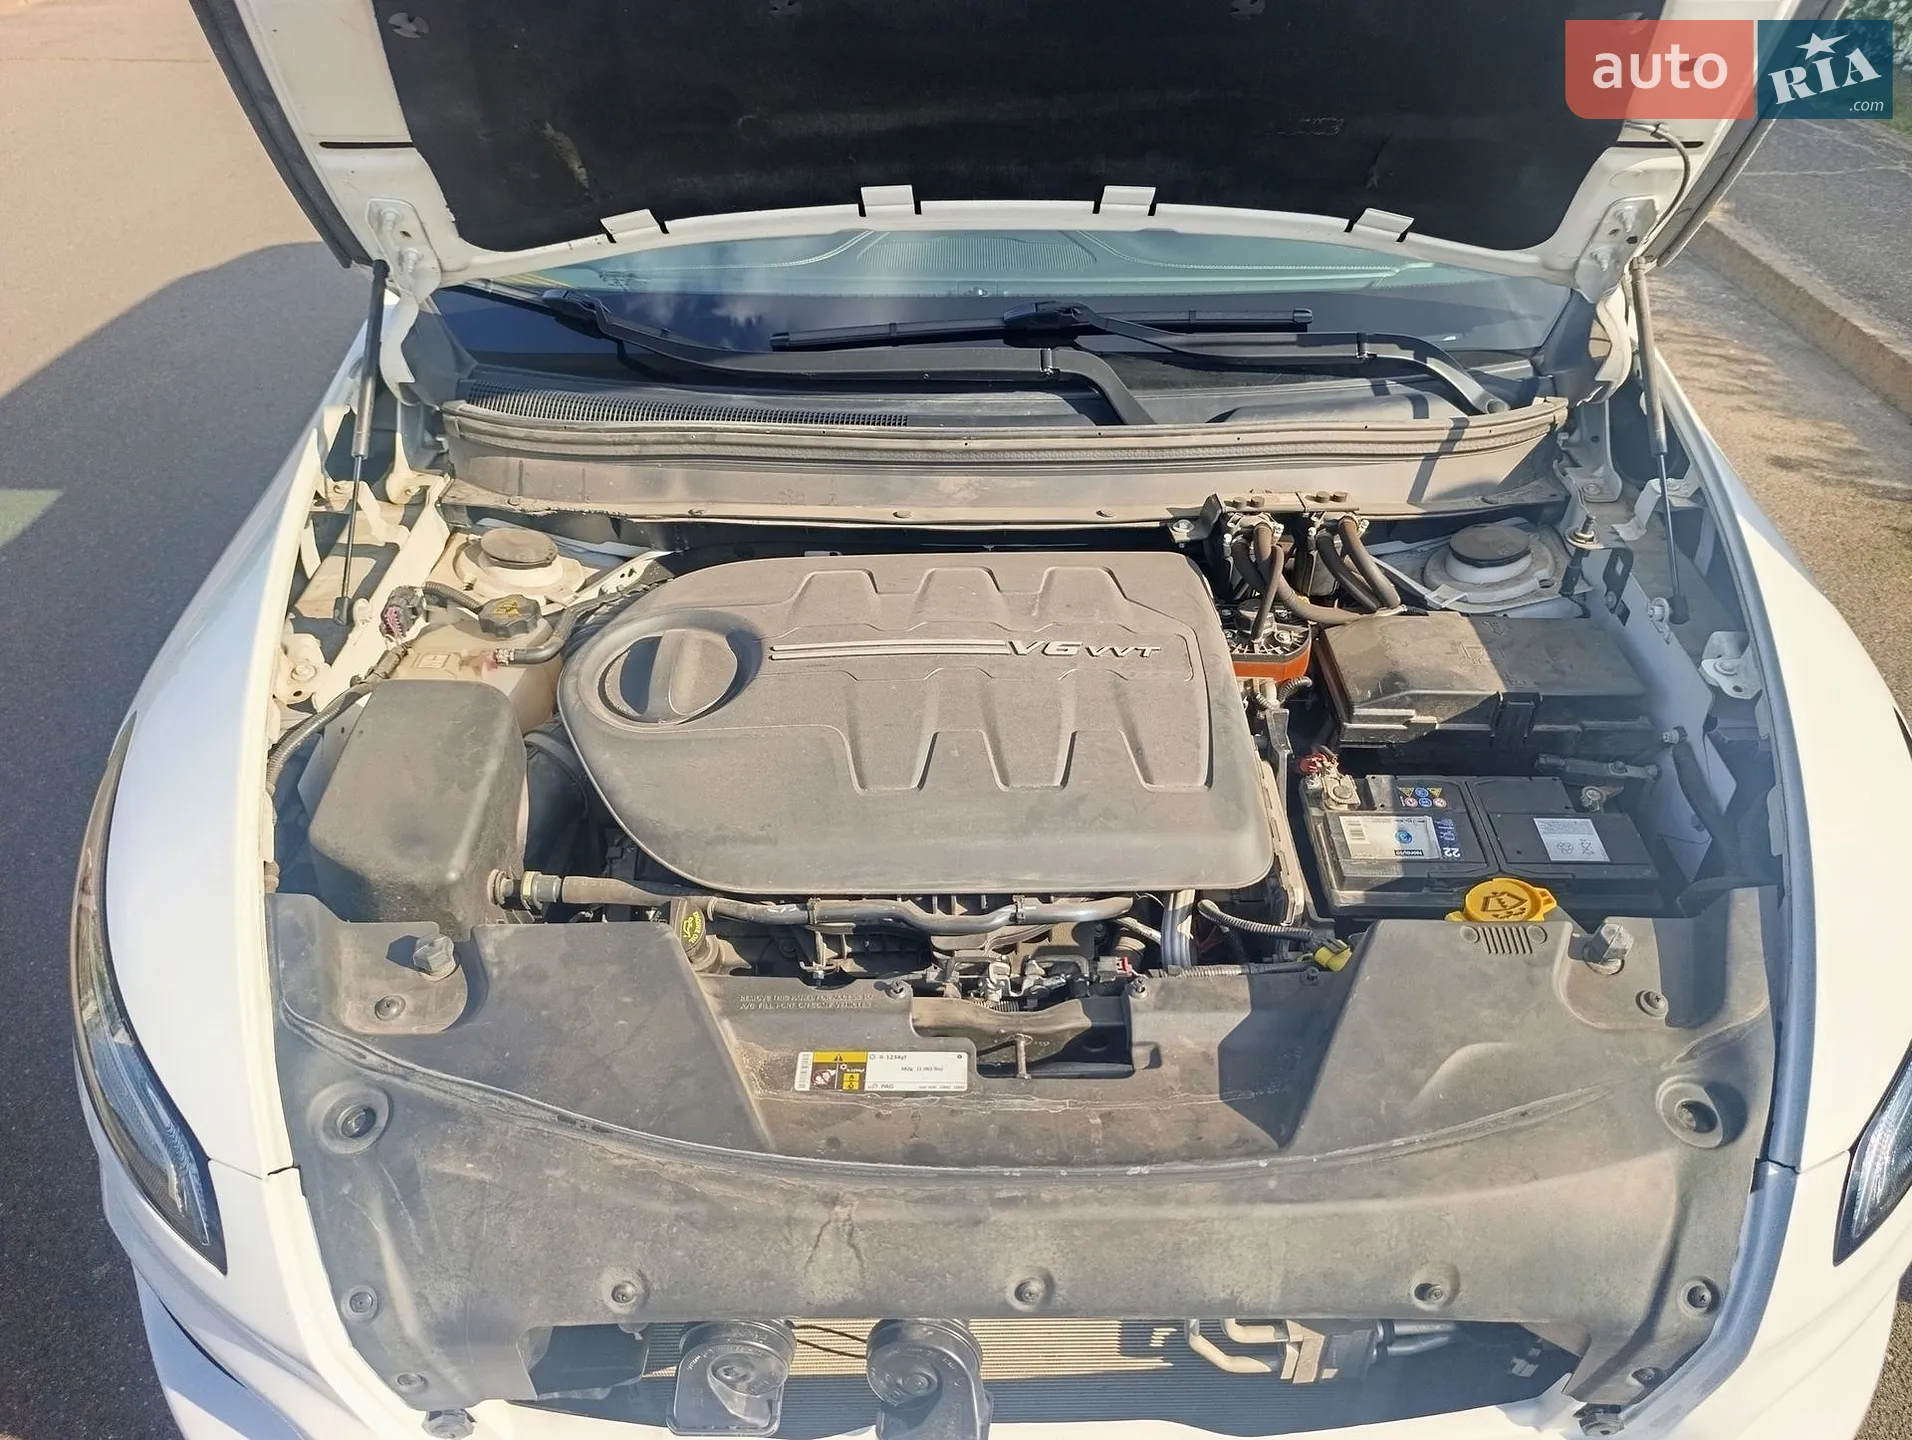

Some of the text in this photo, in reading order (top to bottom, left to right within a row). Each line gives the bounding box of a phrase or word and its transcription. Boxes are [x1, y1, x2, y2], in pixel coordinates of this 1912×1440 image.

[1008, 639, 1161, 658] V6 VVT
[1443, 847, 1461, 858] 22
